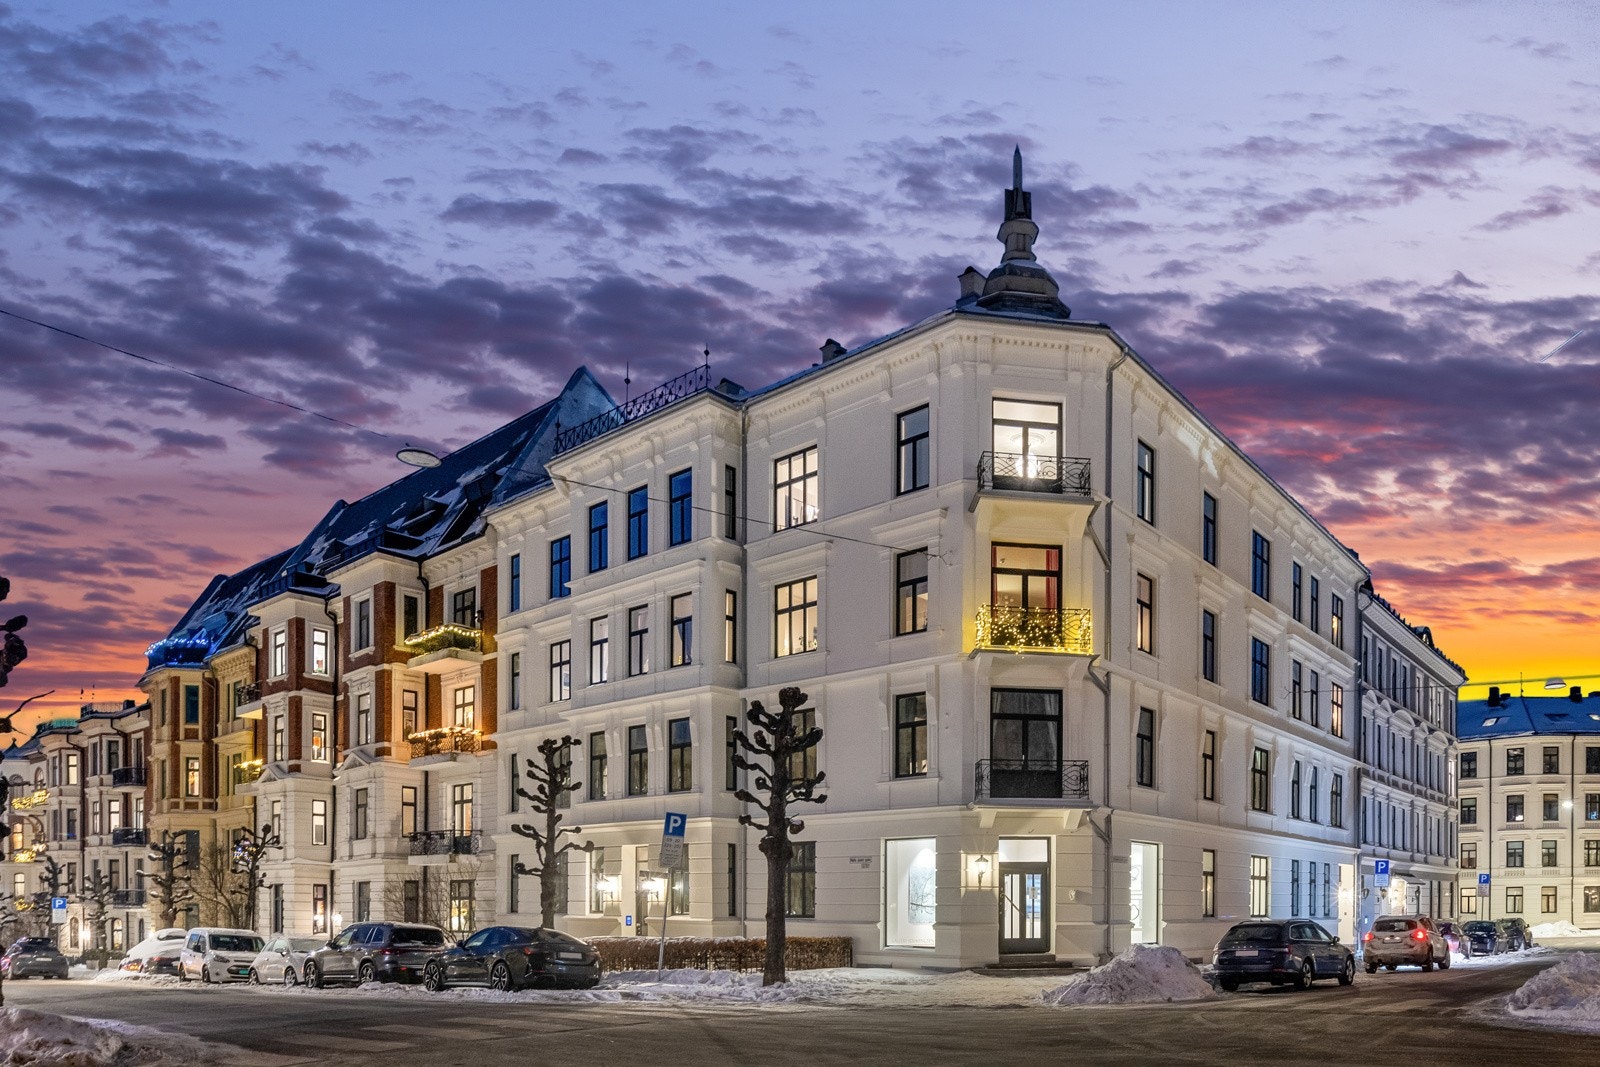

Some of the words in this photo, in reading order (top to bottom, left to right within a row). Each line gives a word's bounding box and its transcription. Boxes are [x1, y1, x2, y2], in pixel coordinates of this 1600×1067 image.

[669, 816, 682, 833] P
[1378, 862, 1386, 872] P
[56, 900, 63, 908] P
